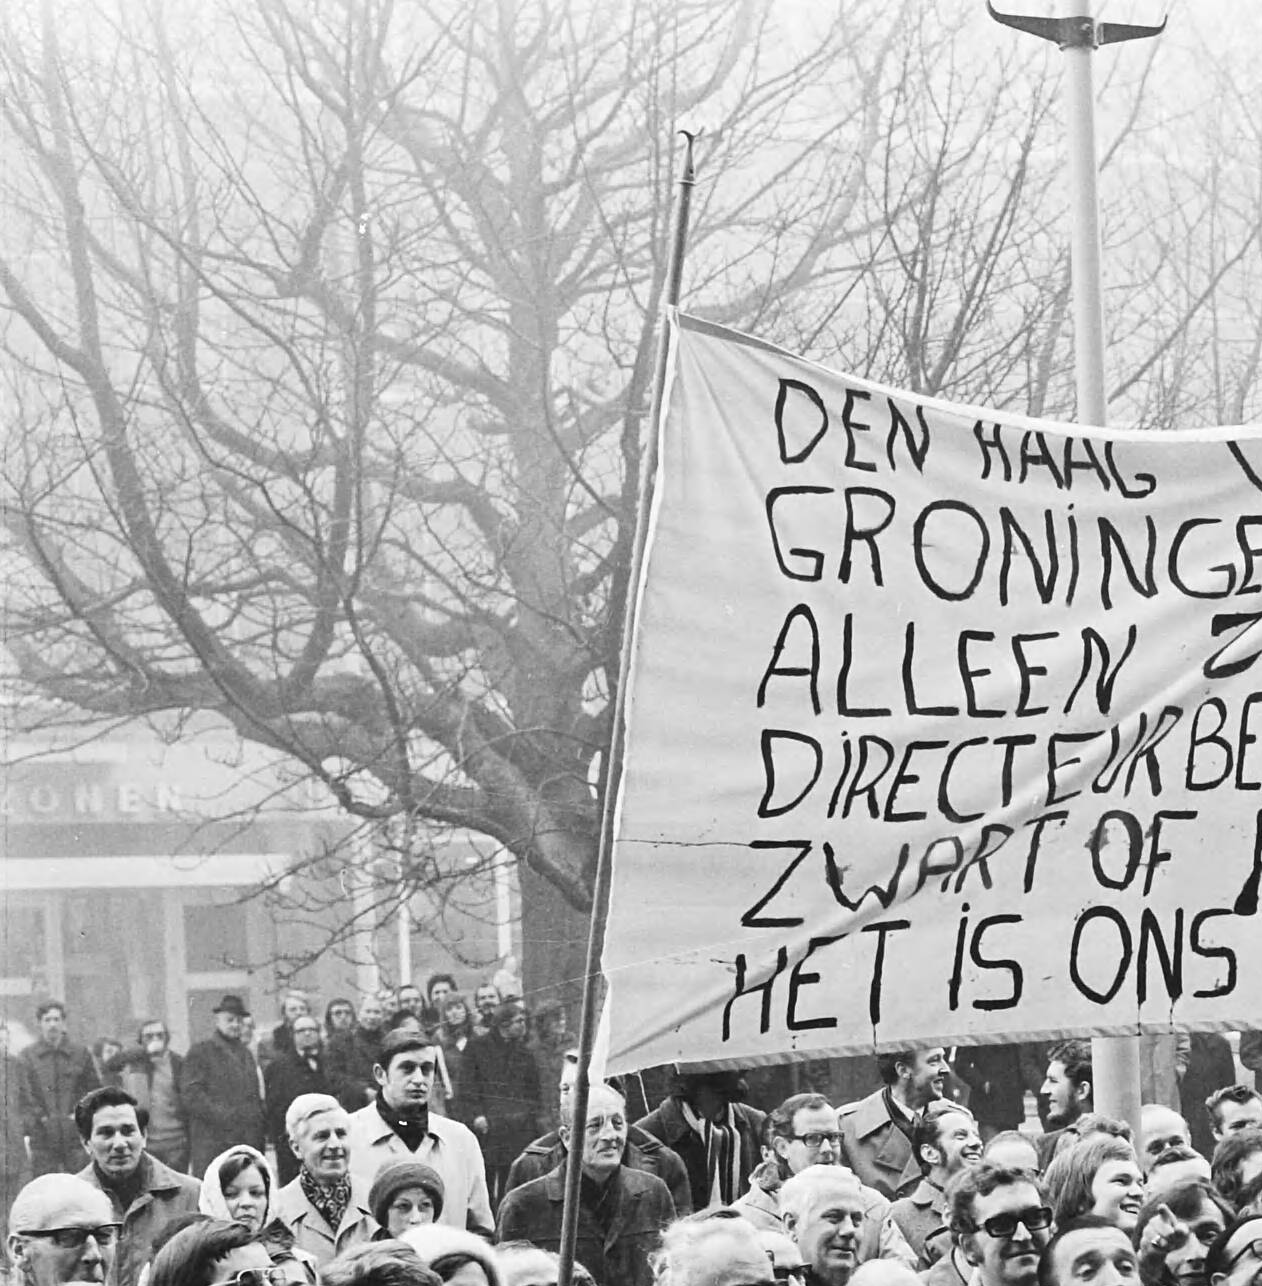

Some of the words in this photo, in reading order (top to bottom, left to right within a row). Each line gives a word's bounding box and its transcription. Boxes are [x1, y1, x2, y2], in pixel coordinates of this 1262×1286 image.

[774, 378, 930, 473] DEN
[973, 420, 1157, 499] HAAG
[756, 603, 1137, 719] ALLEEN
[740, 810, 1069, 928] ZWART
[1084, 809, 1198, 897] OF
[722, 919, 911, 1043] HET
[1069, 905, 1237, 1010] ONS
